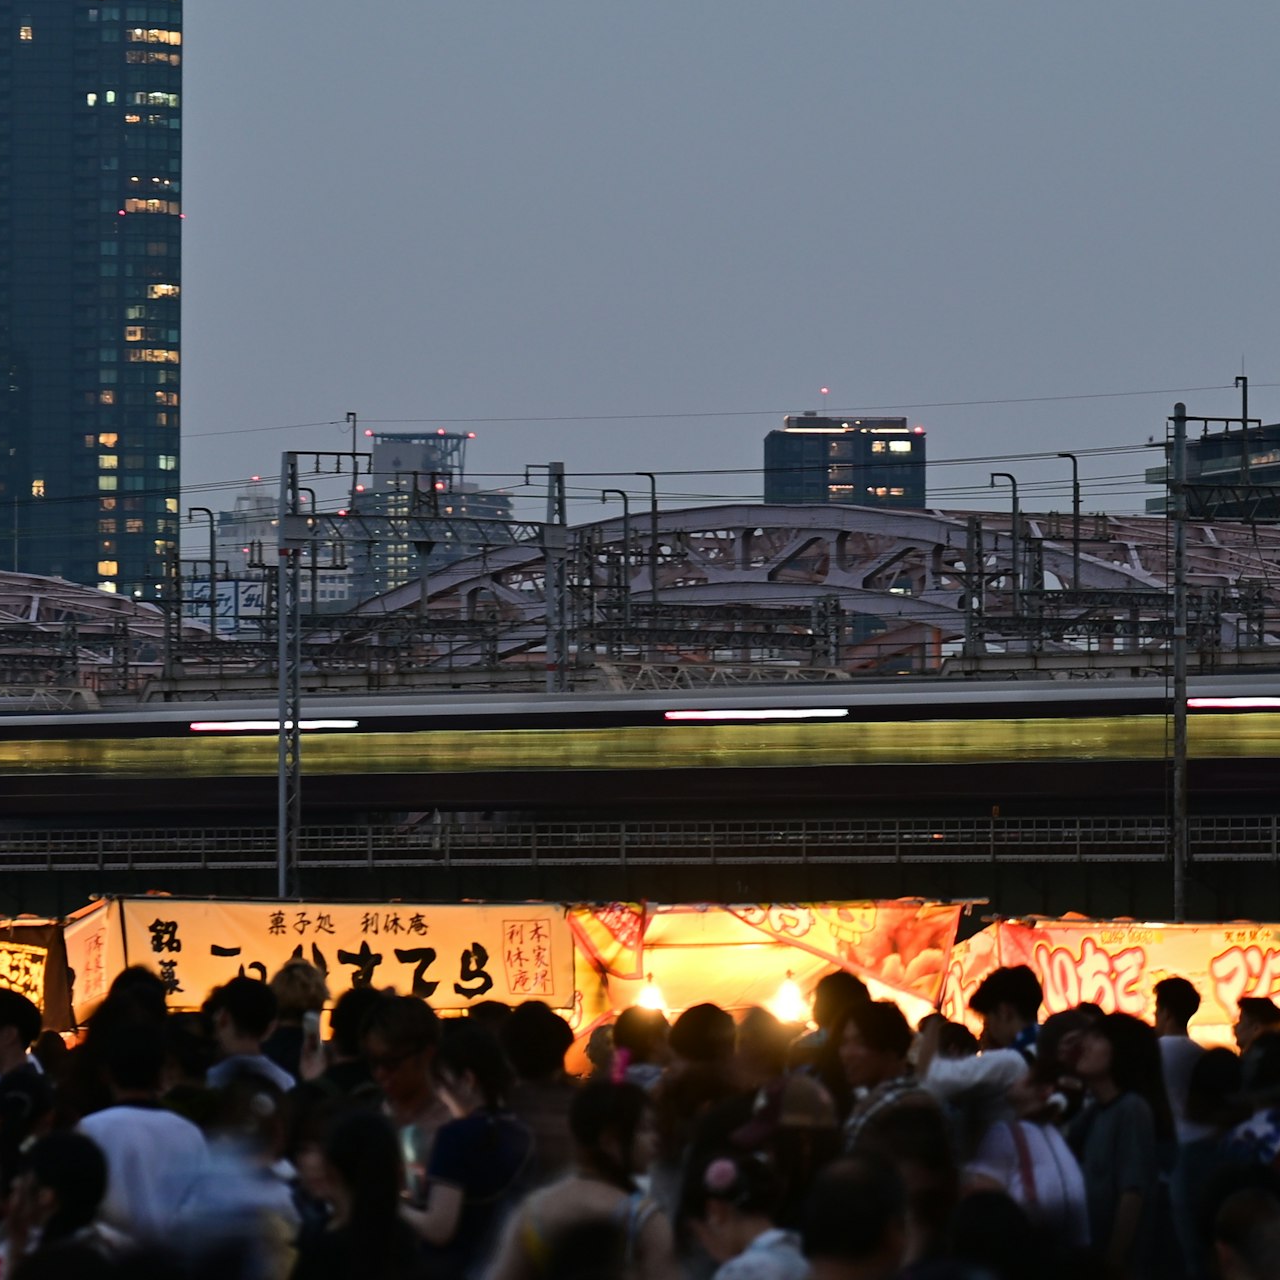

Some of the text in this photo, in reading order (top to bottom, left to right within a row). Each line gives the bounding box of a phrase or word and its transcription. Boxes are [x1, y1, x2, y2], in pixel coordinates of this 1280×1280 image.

[269, 911, 429, 936] 菓子処 利休庵
[506, 924, 532, 992] 利休庵
